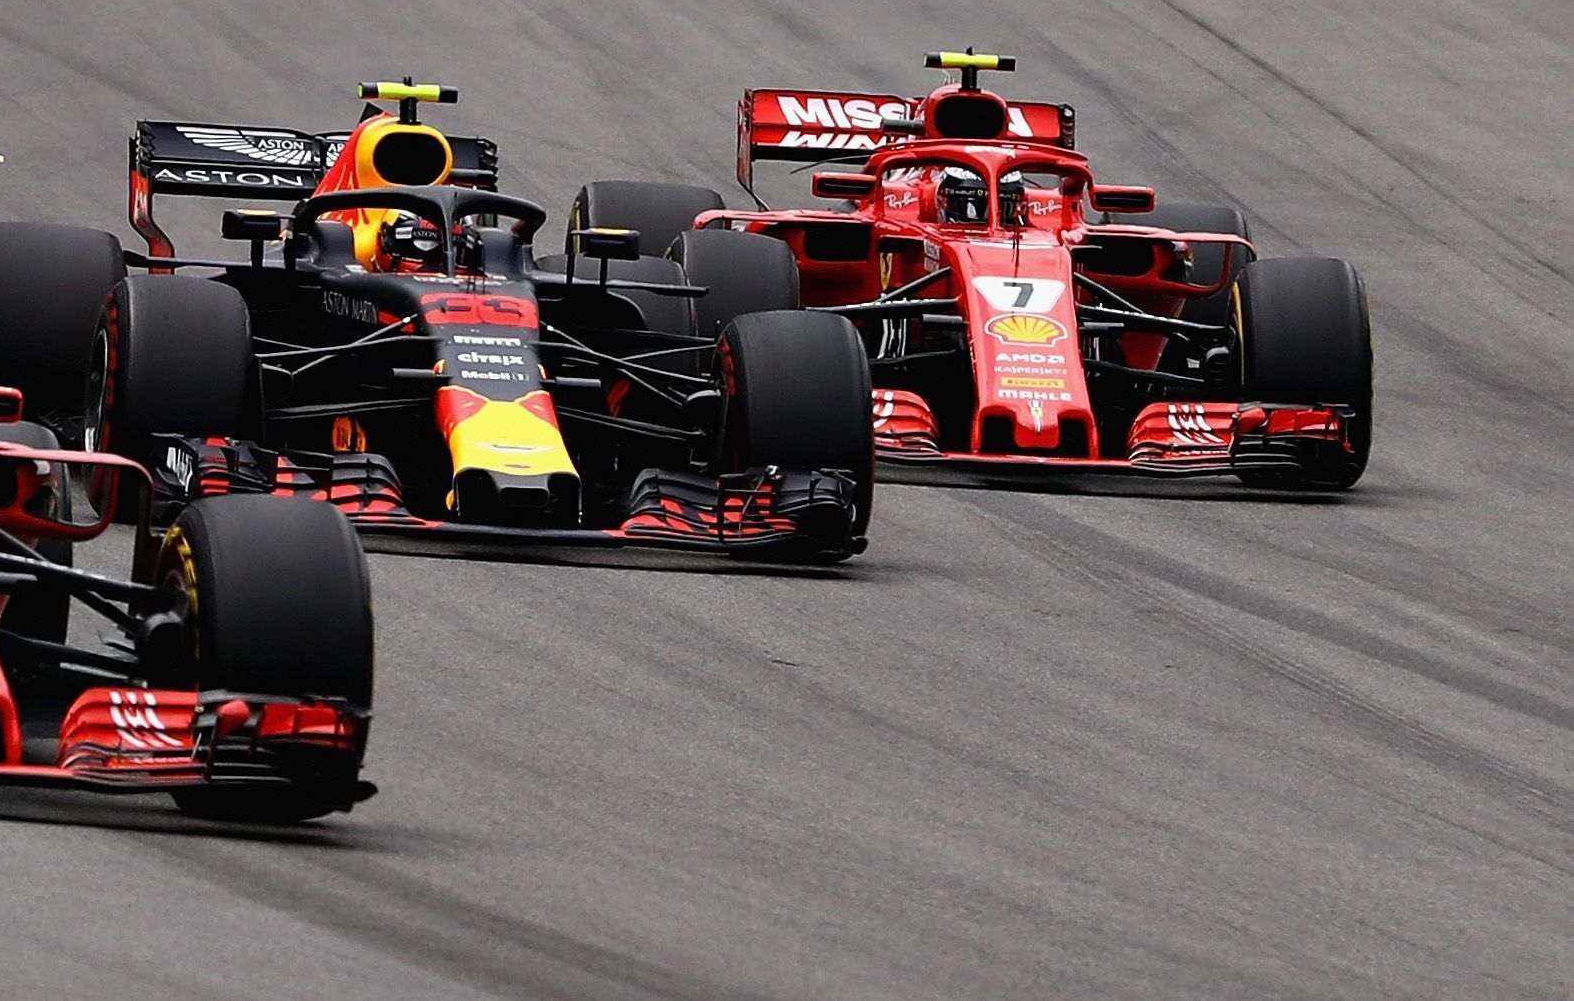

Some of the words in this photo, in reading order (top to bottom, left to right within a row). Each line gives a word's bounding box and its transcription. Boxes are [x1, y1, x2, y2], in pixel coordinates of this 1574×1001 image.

[258, 138, 305, 150] ASTON
[155, 167, 304, 187] ASTON
[1003, 281, 1034, 308] 7
[420, 292, 540, 330] 33
[995, 353, 1046, 363] AMD
[461, 370, 511, 380] Mobil
[998, 389, 1072, 401] MAHLE
